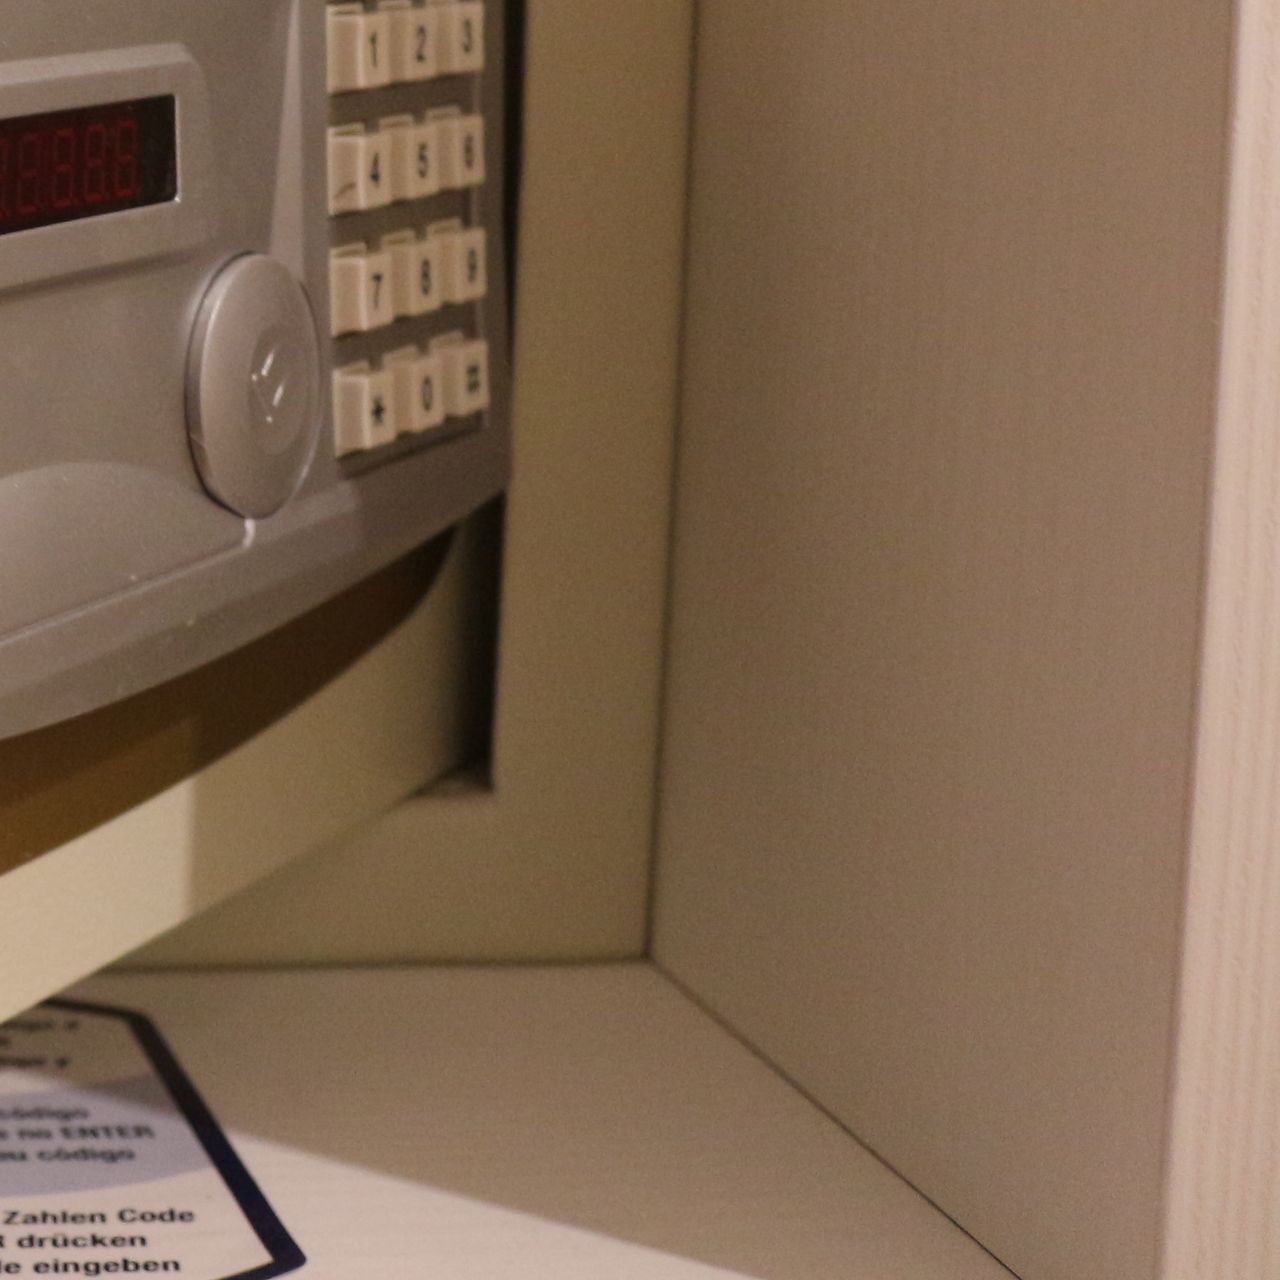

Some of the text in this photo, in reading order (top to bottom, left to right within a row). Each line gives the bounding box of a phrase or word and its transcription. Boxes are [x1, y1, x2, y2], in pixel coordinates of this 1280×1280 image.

[369, 31, 378, 68] 1
[416, 24, 427, 63] 2
[370, 152, 381, 185] 4
[372, 272, 383, 310] 7
[59, 1125, 156, 1139] ENTER
[37, 1148, 135, 1164] código
[2, 1209, 108, 1225] Zahlen
[117, 1207, 196, 1224] Code
[17, 1232, 148, 1249] drücken
[32, 1257, 182, 1278] eingeben
